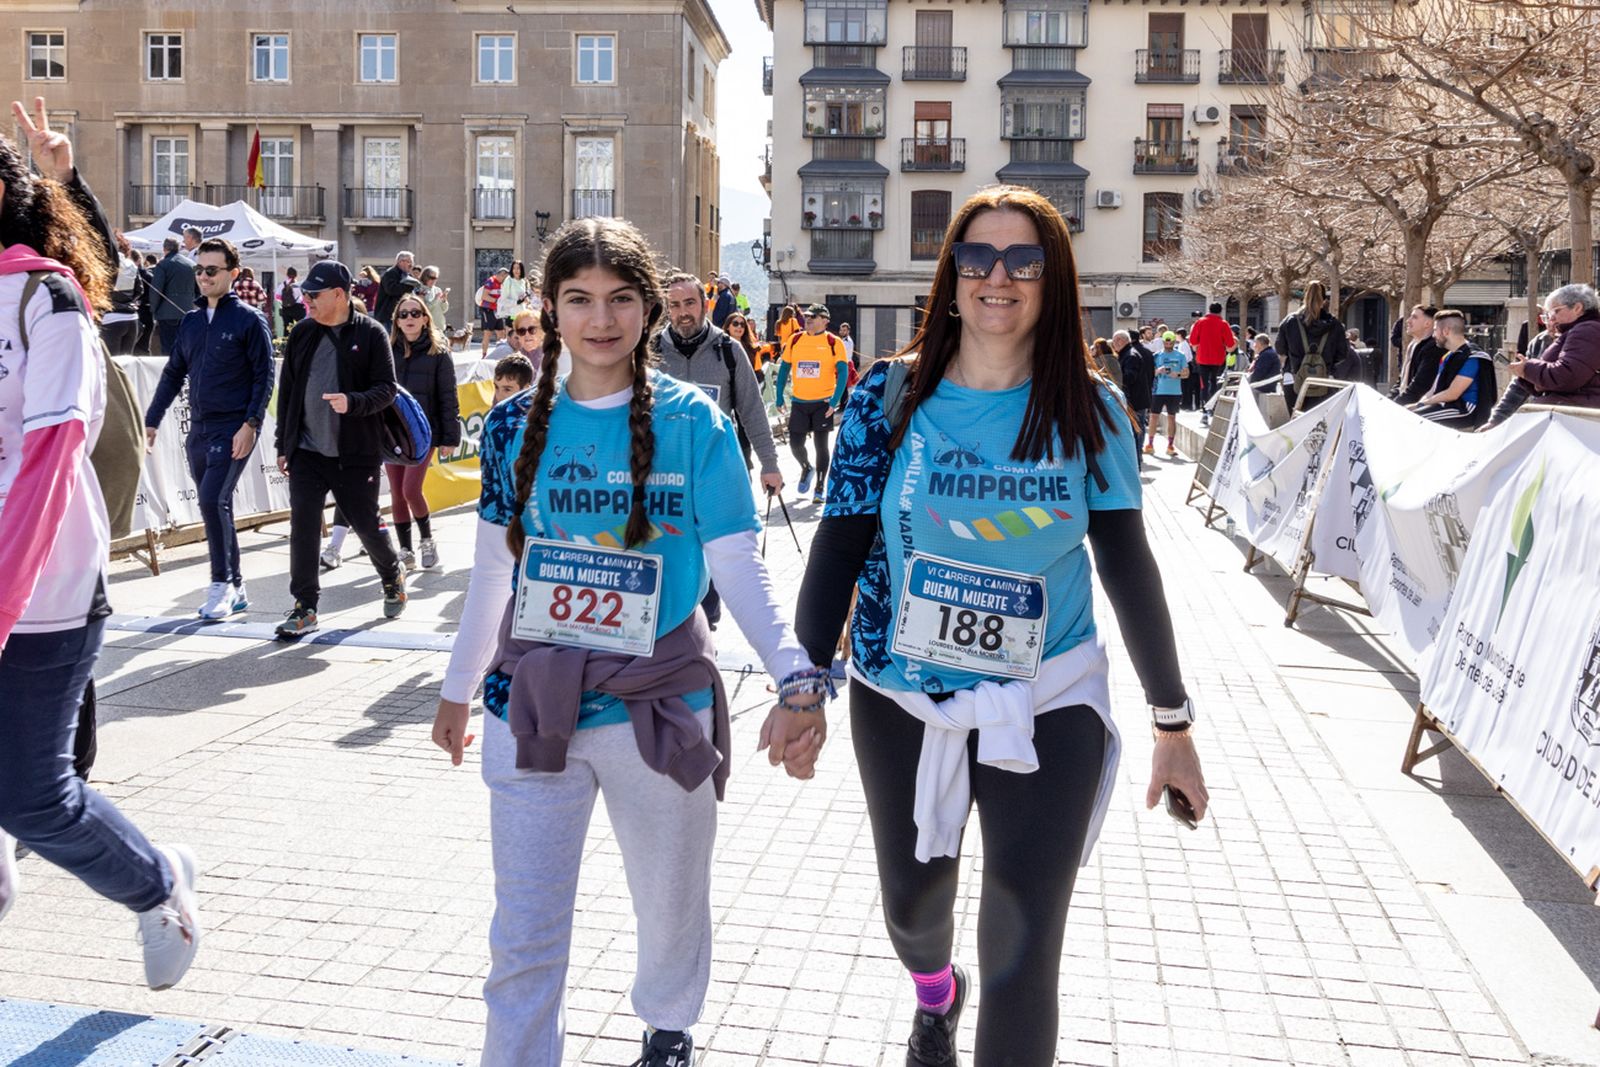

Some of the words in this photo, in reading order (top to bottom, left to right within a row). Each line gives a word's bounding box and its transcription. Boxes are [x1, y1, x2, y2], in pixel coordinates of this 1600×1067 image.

[607, 471, 685, 487] COMNIDAD
[928, 472, 1071, 502] MAPACHE
[548, 488, 685, 517] MAPAHE
[539, 562, 574, 581] BUENA
[577, 568, 621, 587] MUERTE
[542, 548, 551, 559] VI
[552, 550, 594, 564] CARRERA
[596, 556, 643, 571] CAMINATA
[922, 580, 959, 601] BUENA
[962, 589, 1009, 611] MUERTE
[927, 566, 936, 576] VI
[937, 566, 981, 586] CARRERA
[984, 578, 1032, 596] CAMINATA
[549, 584, 624, 629] 822
[938, 604, 1004, 651] 188
[929, 639, 953, 651] LOURDES
[954, 644, 978, 656] MOLINA
[979, 649, 1006, 660] MORENO
[1576, 765, 1597, 799] DE
